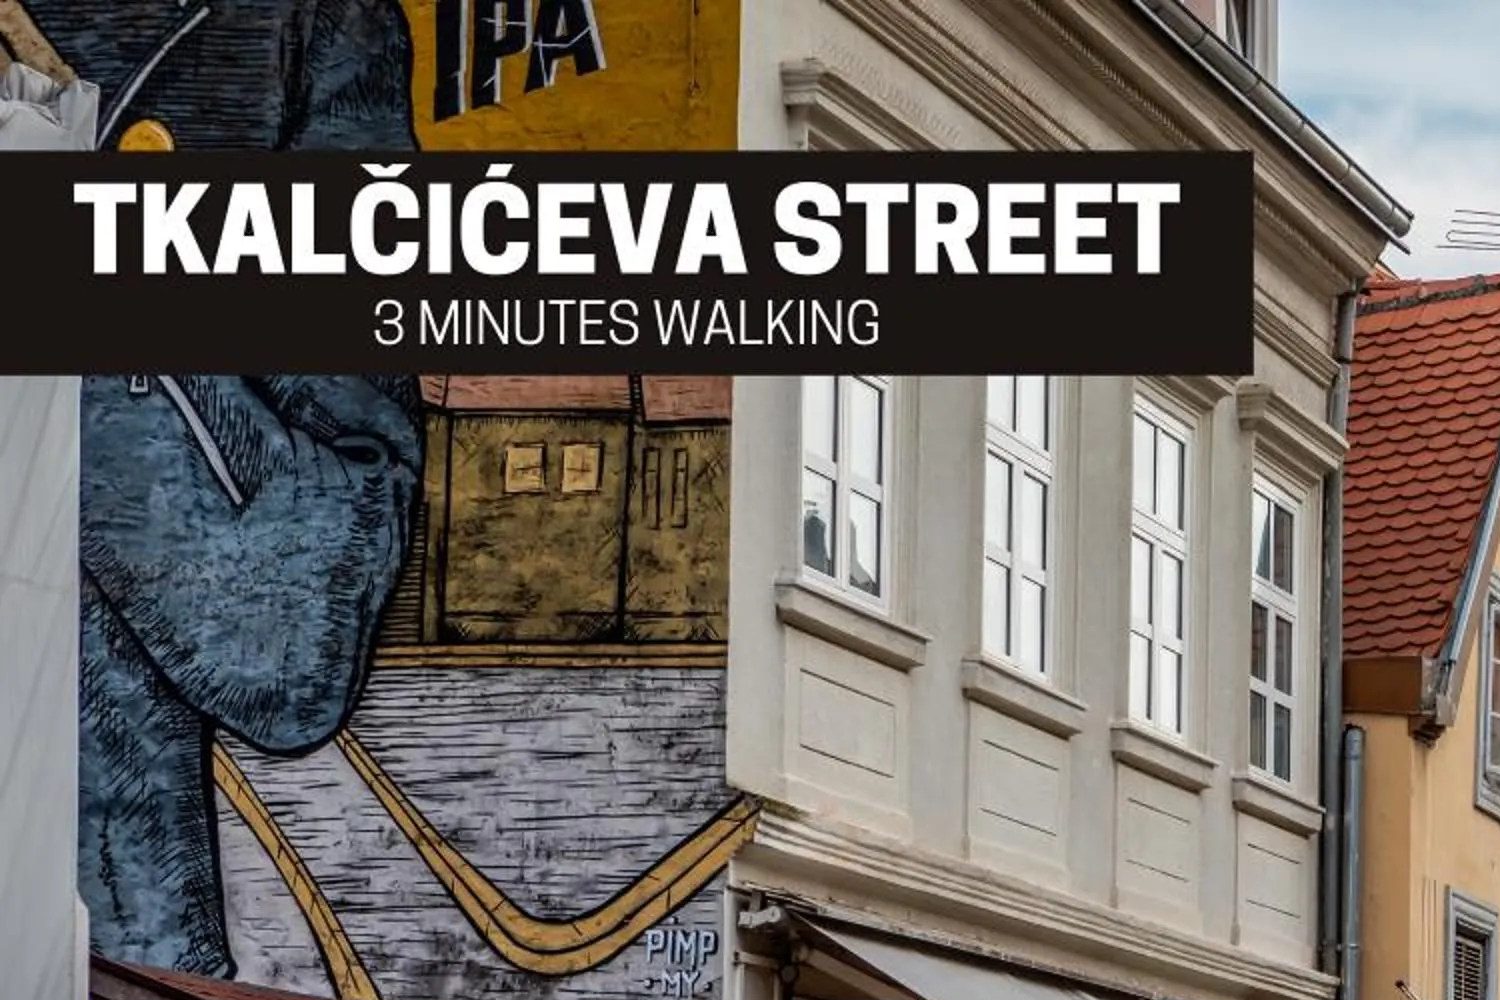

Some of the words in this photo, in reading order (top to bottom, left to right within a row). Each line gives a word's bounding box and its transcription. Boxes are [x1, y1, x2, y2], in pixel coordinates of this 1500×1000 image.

[434, 0, 607, 123] IPA
[645, 929, 718, 969] PIMP
[661, 970, 700, 999] MY
